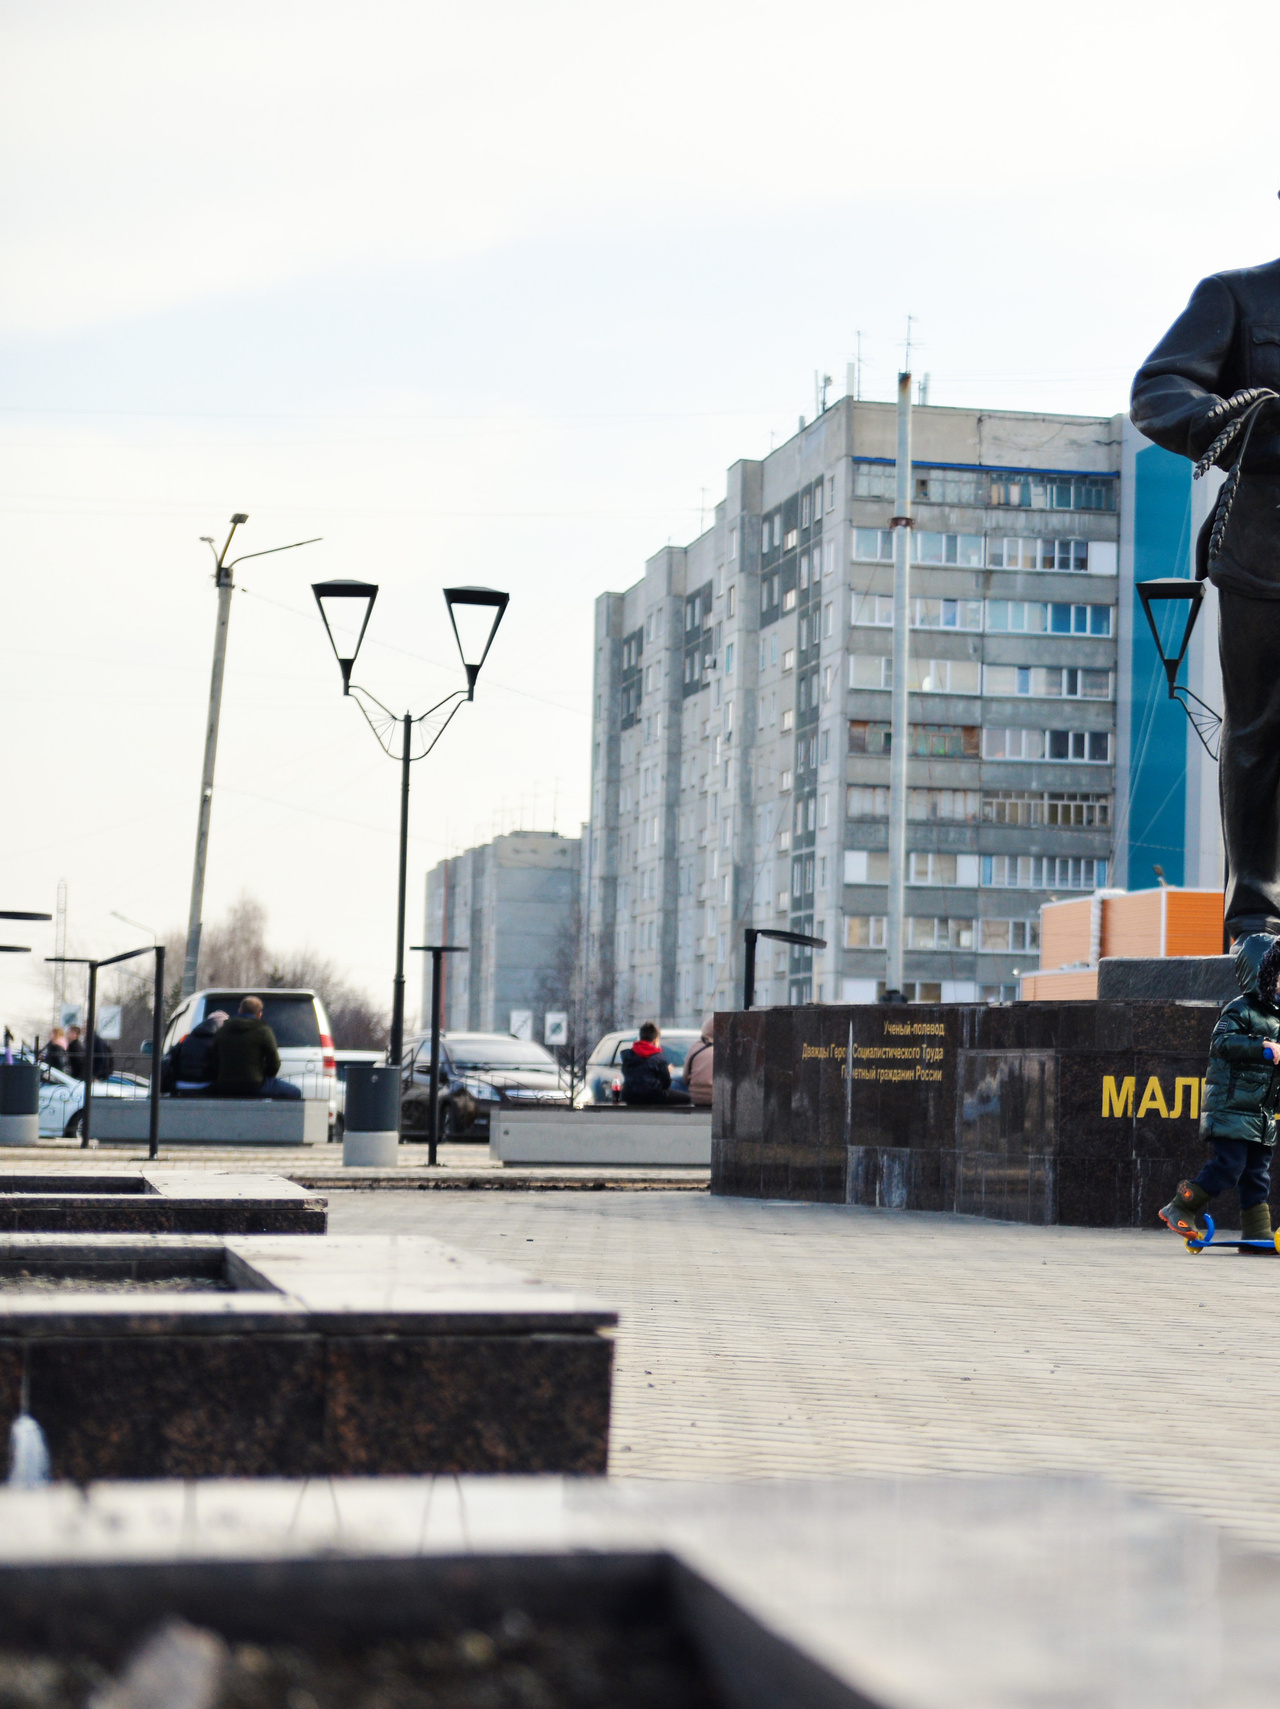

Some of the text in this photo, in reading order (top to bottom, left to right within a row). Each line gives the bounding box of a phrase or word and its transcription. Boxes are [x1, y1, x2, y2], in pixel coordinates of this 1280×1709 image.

[802, 1043, 829, 1060] Дважды
[922, 1044, 944, 1063] Труда
[877, 1069, 914, 1083] гражданин
[915, 1065, 942, 1081] России
